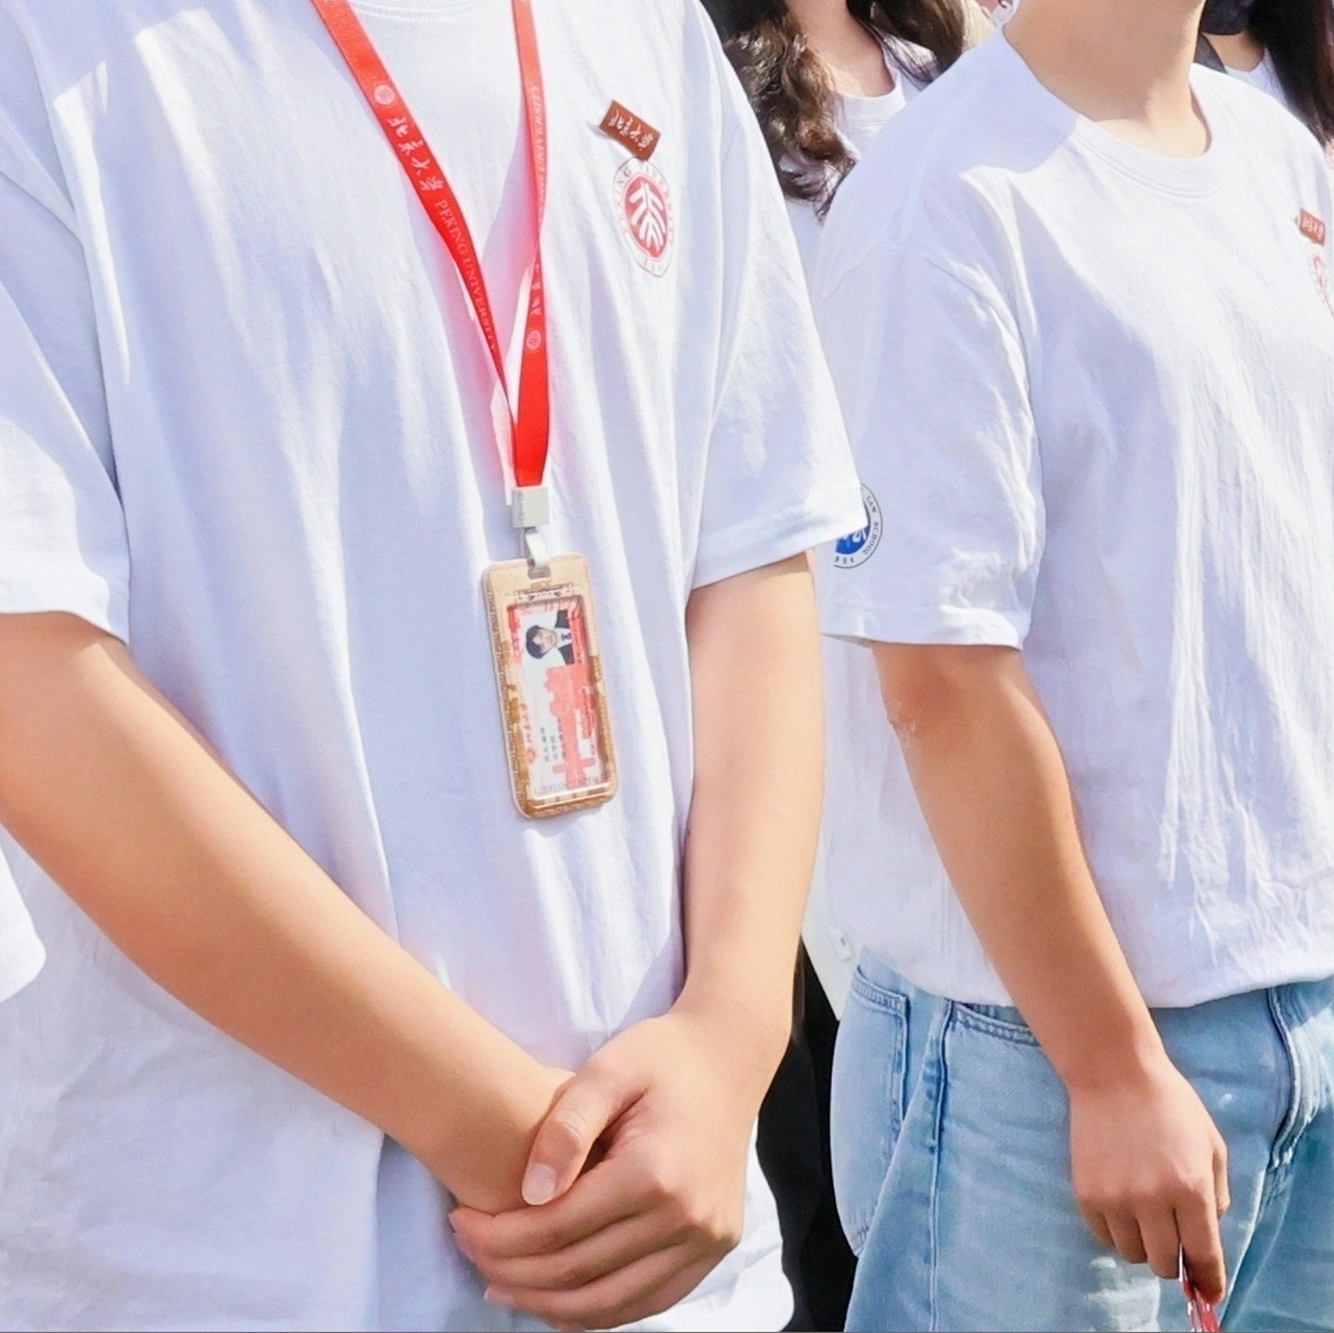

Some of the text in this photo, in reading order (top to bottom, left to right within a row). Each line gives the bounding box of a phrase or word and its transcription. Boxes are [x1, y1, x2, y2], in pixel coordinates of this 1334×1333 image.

[387, 115, 445, 193] 北京大学
[435, 198, 497, 352] PEKING UNIVERSITY
[862, 495, 880, 556] LAW SCHOOL
